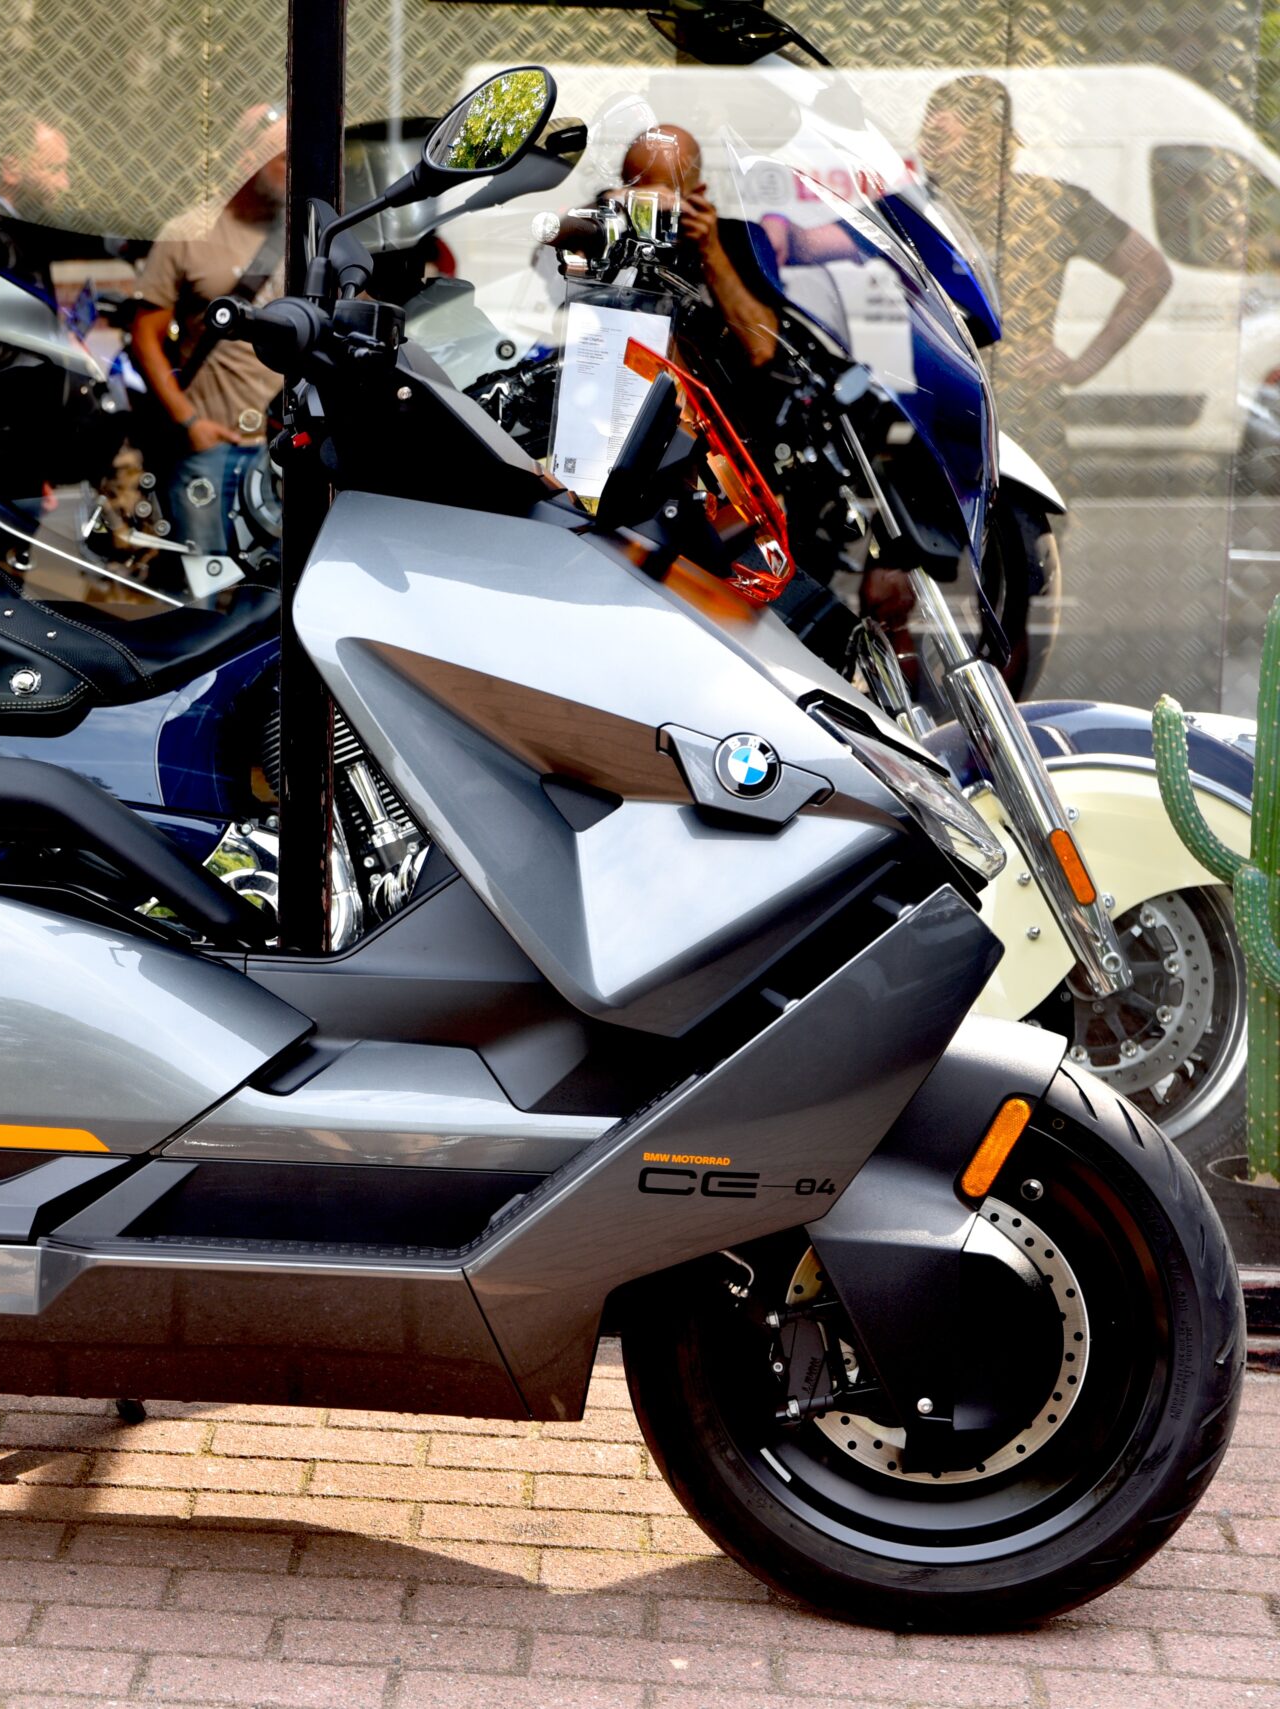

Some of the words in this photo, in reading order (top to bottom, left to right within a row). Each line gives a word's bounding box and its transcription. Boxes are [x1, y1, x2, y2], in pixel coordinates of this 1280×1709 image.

[728, 736, 777, 764] BMW
[643, 1152, 671, 1163] BMW
[671, 1154, 731, 1166] MOTORRAD
[638, 1167, 760, 1198] CE
[795, 1178, 836, 1195] 04
